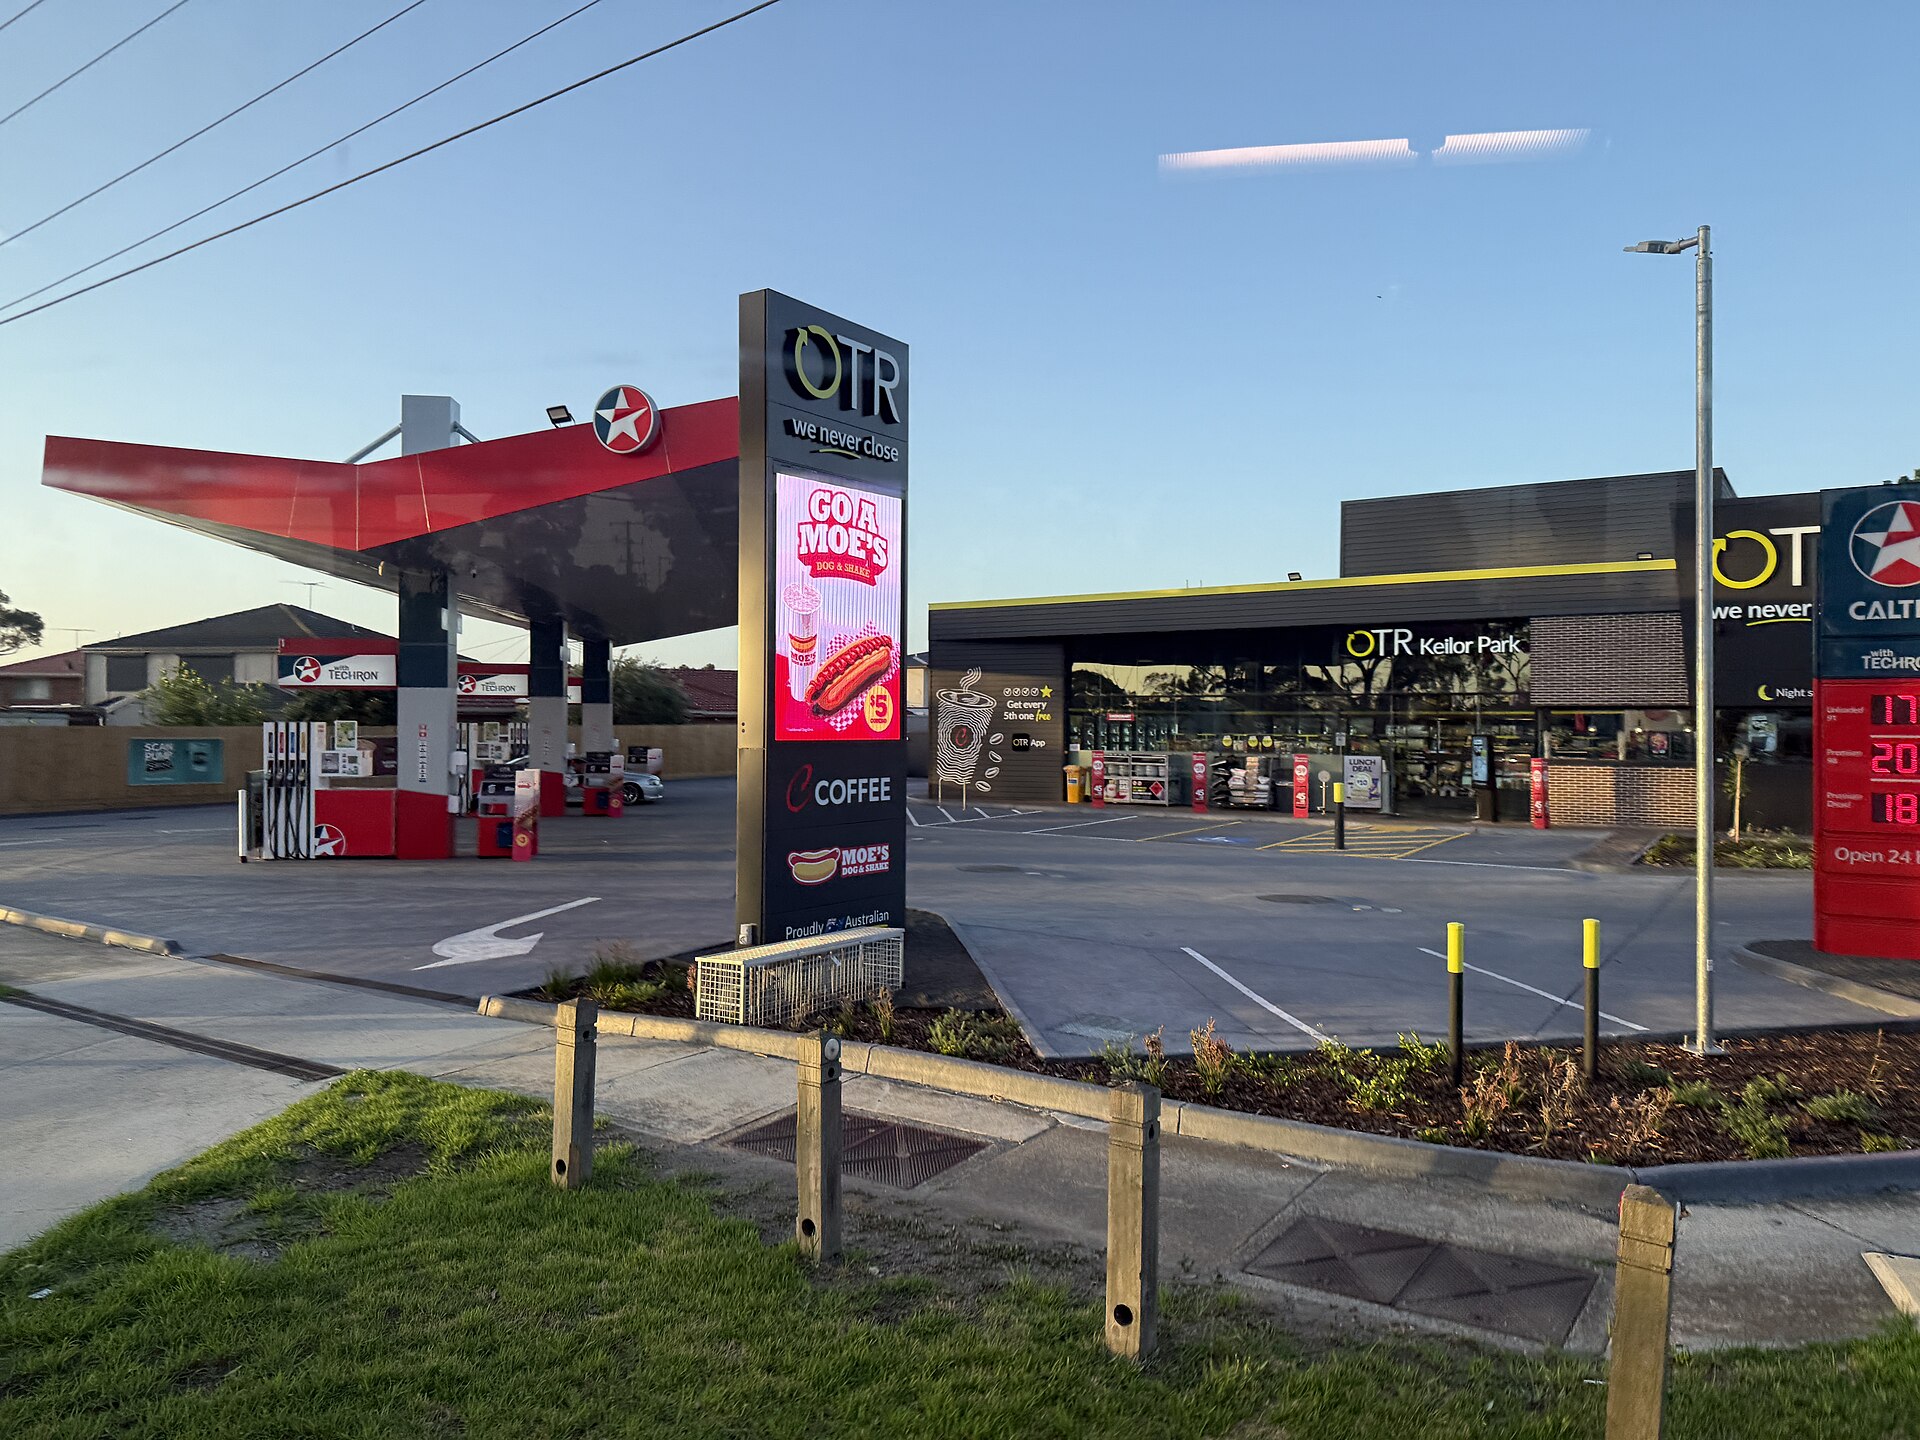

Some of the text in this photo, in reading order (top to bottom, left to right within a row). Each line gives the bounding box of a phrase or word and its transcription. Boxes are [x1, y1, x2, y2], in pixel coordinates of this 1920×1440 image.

[792, 325, 900, 423] OTR
[791, 418, 899, 461] we never close
[808, 489, 878, 535] GO A
[798, 521, 888, 568] MOE'S
[816, 561, 835, 571] DOG
[844, 563, 871, 578] SHAKE
[1712, 603, 1812, 620] we never
[1346, 628, 1521, 657] OTR Keilor Park
[1870, 649, 1894, 657] with
[328, 669, 379, 682] TECHRON
[480, 683, 516, 693] TECHRON
[1775, 687, 1806, 699] Night
[870, 694, 888, 717] $5
[1007, 700, 1047, 710] Get every
[1003, 712, 1018, 720] 5th
[1035, 709, 1052, 722] free
[1013, 739, 1046, 747] OTR App
[814, 777, 891, 806] COFFEE
[841, 844, 890, 866] MOE'S
[1834, 847, 1884, 865] Open
[1888, 849, 1912, 864] 24
[841, 861, 890, 876] DOG & SHAKE
[785, 909, 890, 940] Proudly Australian
